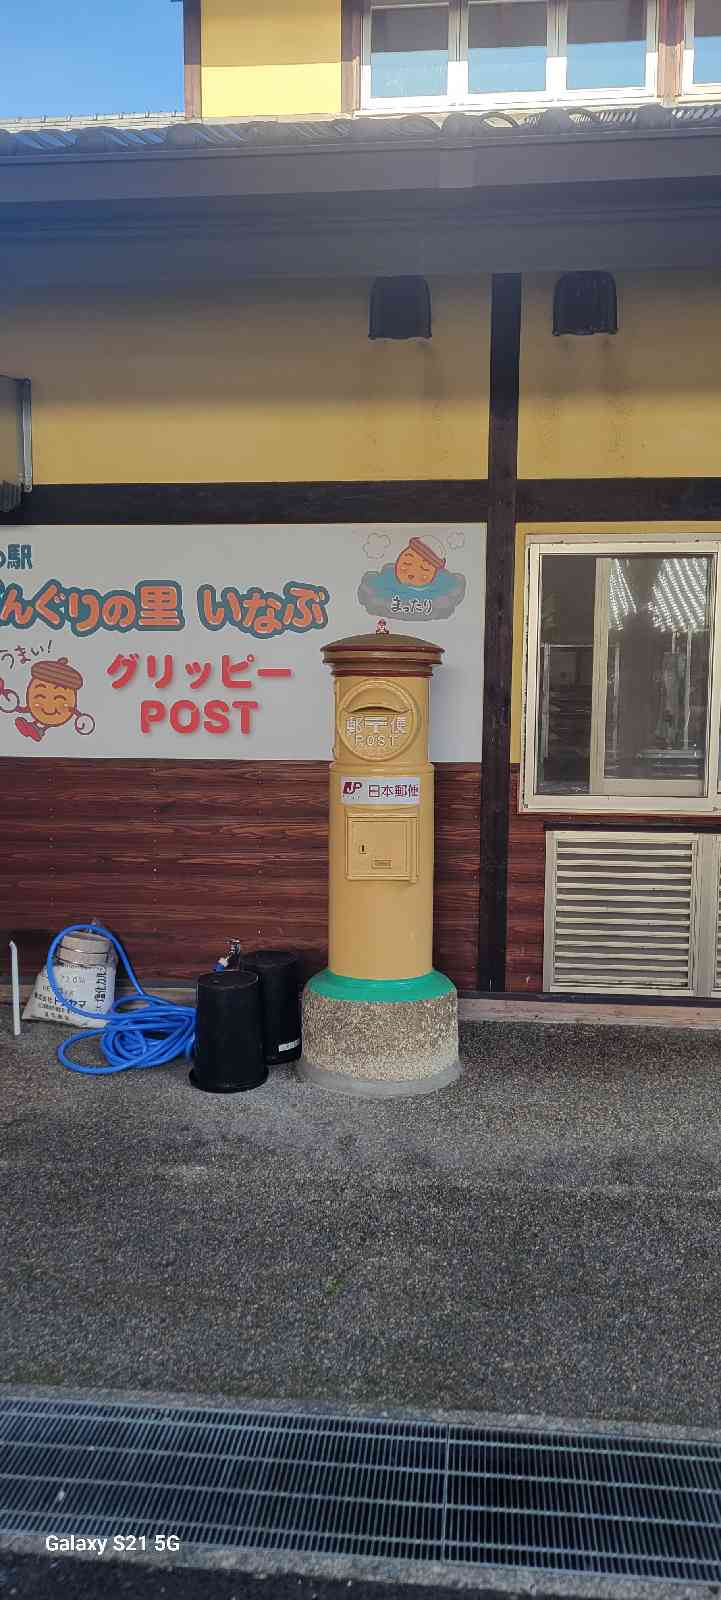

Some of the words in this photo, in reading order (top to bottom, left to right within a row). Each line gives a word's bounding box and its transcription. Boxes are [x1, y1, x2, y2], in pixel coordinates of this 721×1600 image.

[0, 580, 184, 636] んぐりの里
[198, 582, 329, 637] いなぶ
[389, 596, 433, 616] まったり
[105, 653, 293, 690] グリッピー
[139, 699, 260, 735] POST
[354, 735, 398, 746] POST
[368, 783, 419, 799] 日本郵便
